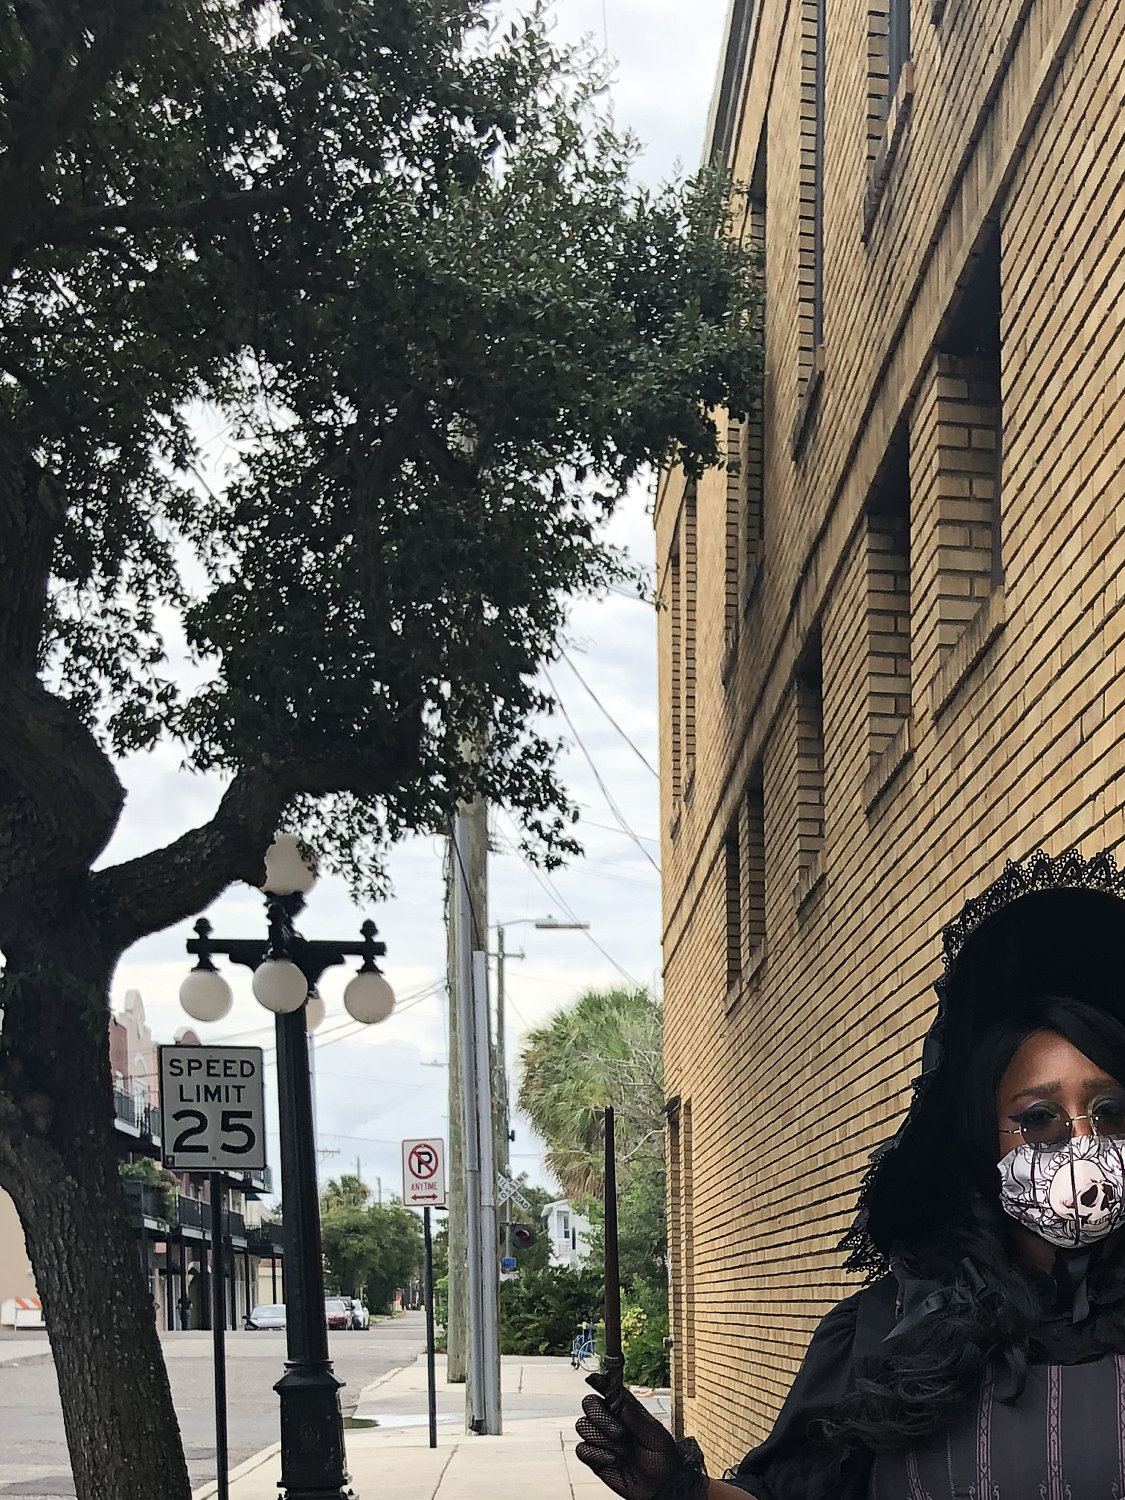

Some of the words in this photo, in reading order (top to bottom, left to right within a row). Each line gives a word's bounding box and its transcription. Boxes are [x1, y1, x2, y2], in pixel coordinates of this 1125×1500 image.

[168, 1058, 256, 1078] SPEED
[179, 1084, 247, 1104] LIMIT
[171, 1109, 256, 1154] 25
[416, 1150, 433, 1174] P
[410, 1181, 438, 1192] ANYTIME
[498, 1170, 530, 1202] OSSING
